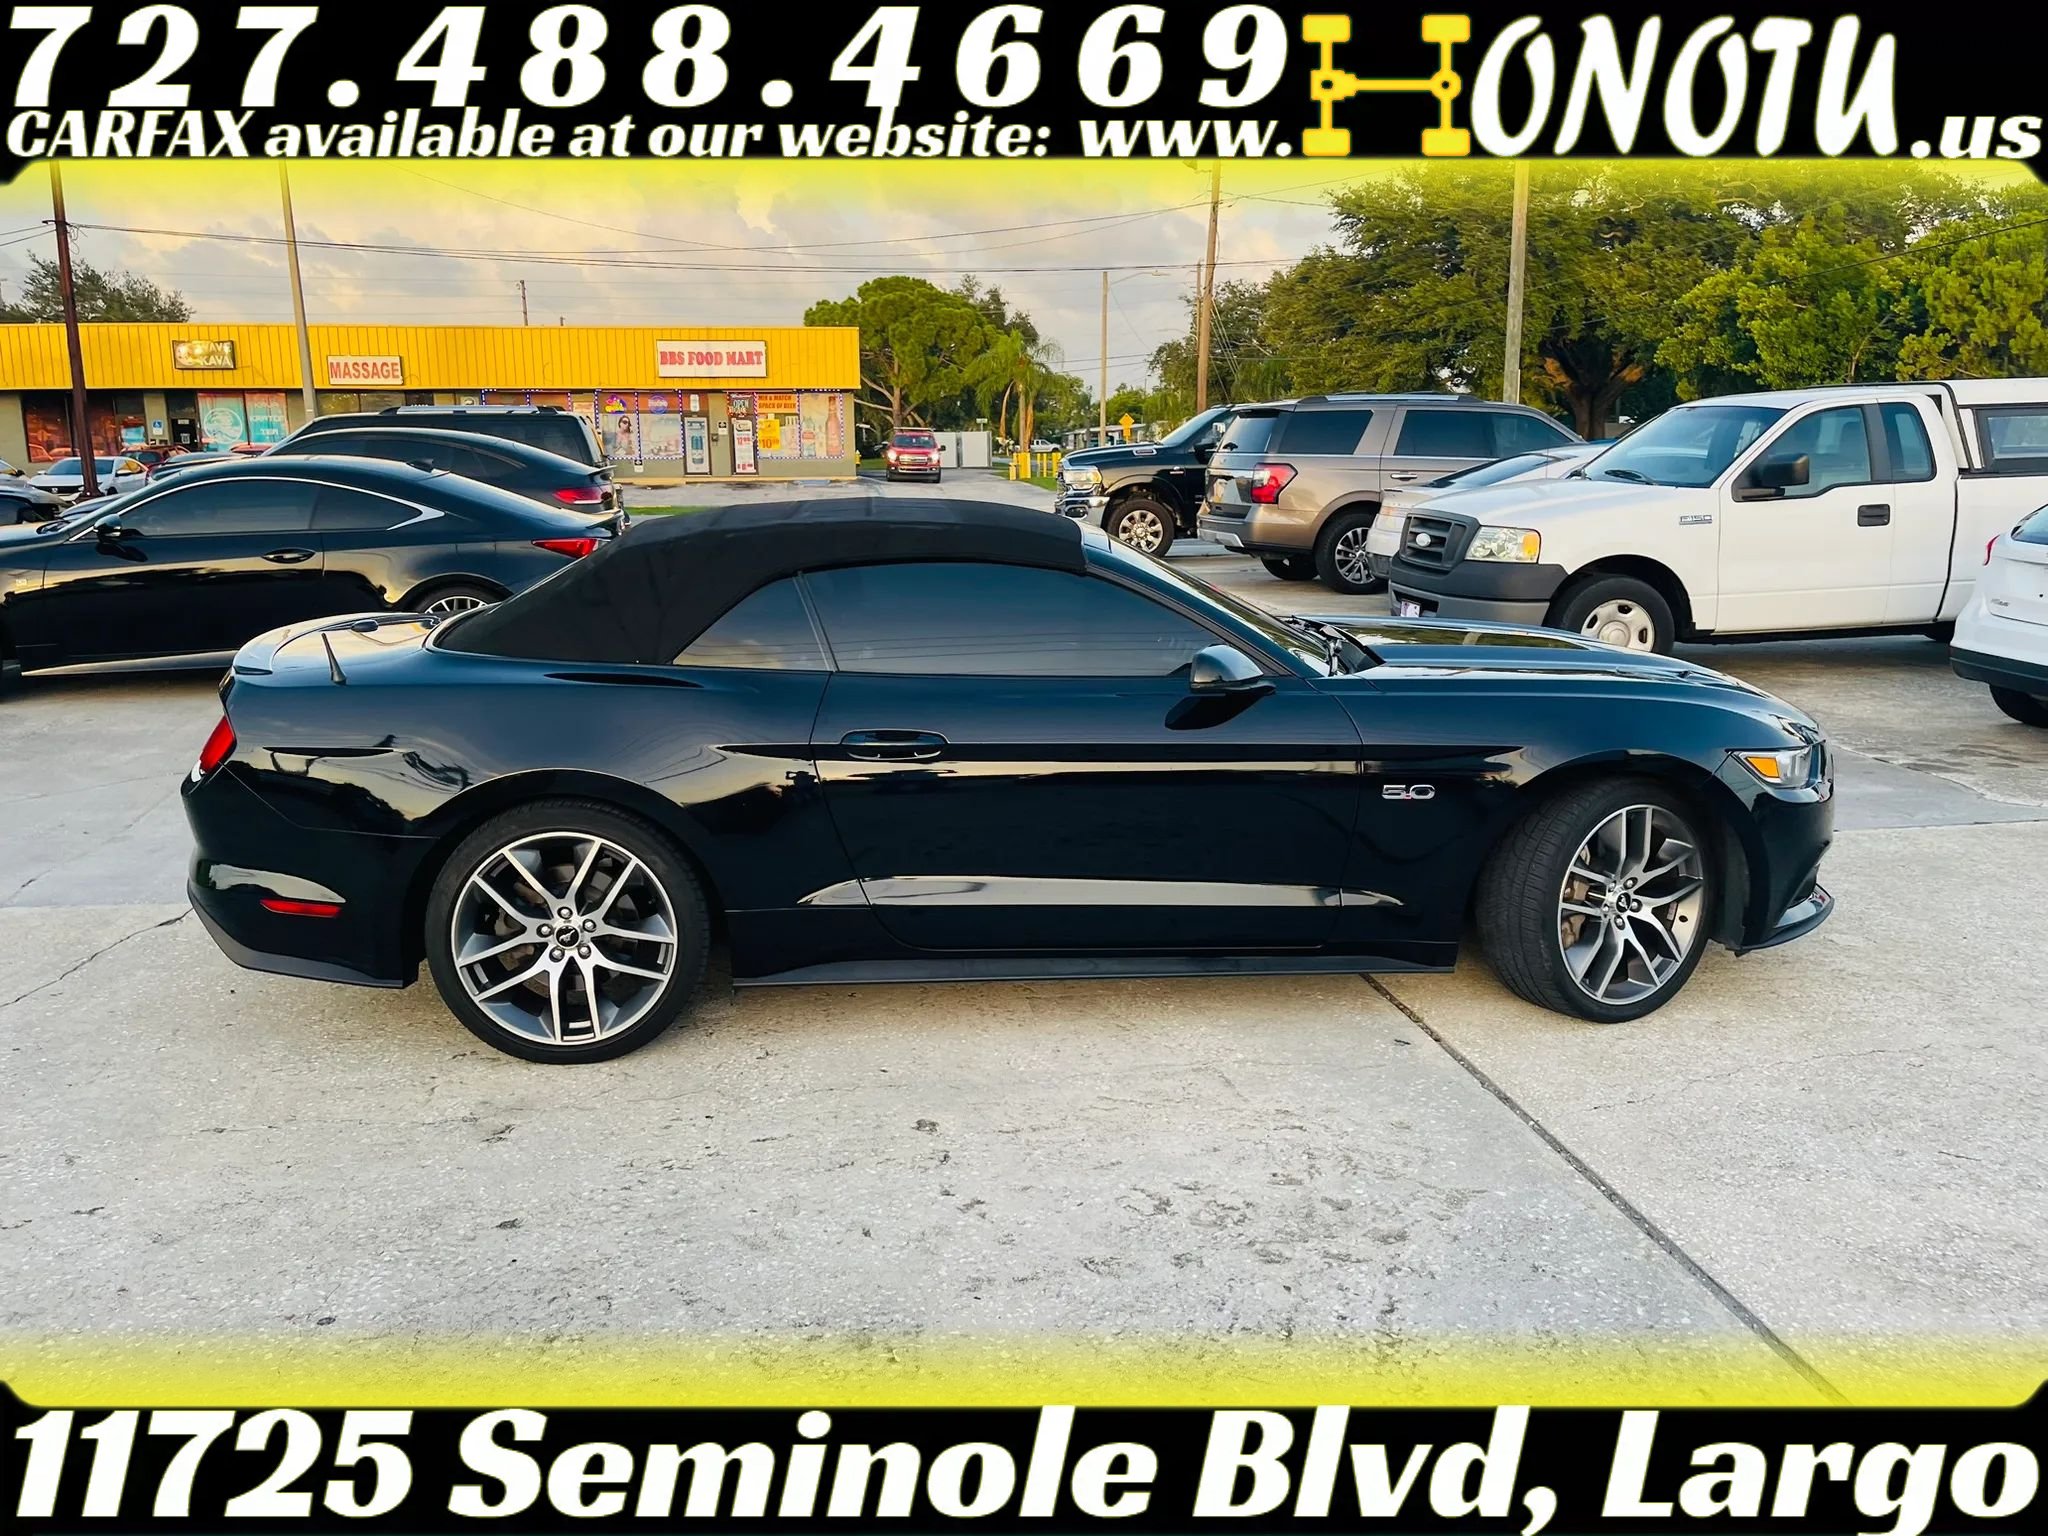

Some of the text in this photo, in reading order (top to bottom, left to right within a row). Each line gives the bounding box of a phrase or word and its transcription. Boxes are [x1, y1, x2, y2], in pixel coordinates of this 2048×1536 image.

[659, 351, 764, 366] BBS FOOD MART
[329, 361, 400, 379] MASSAGE
